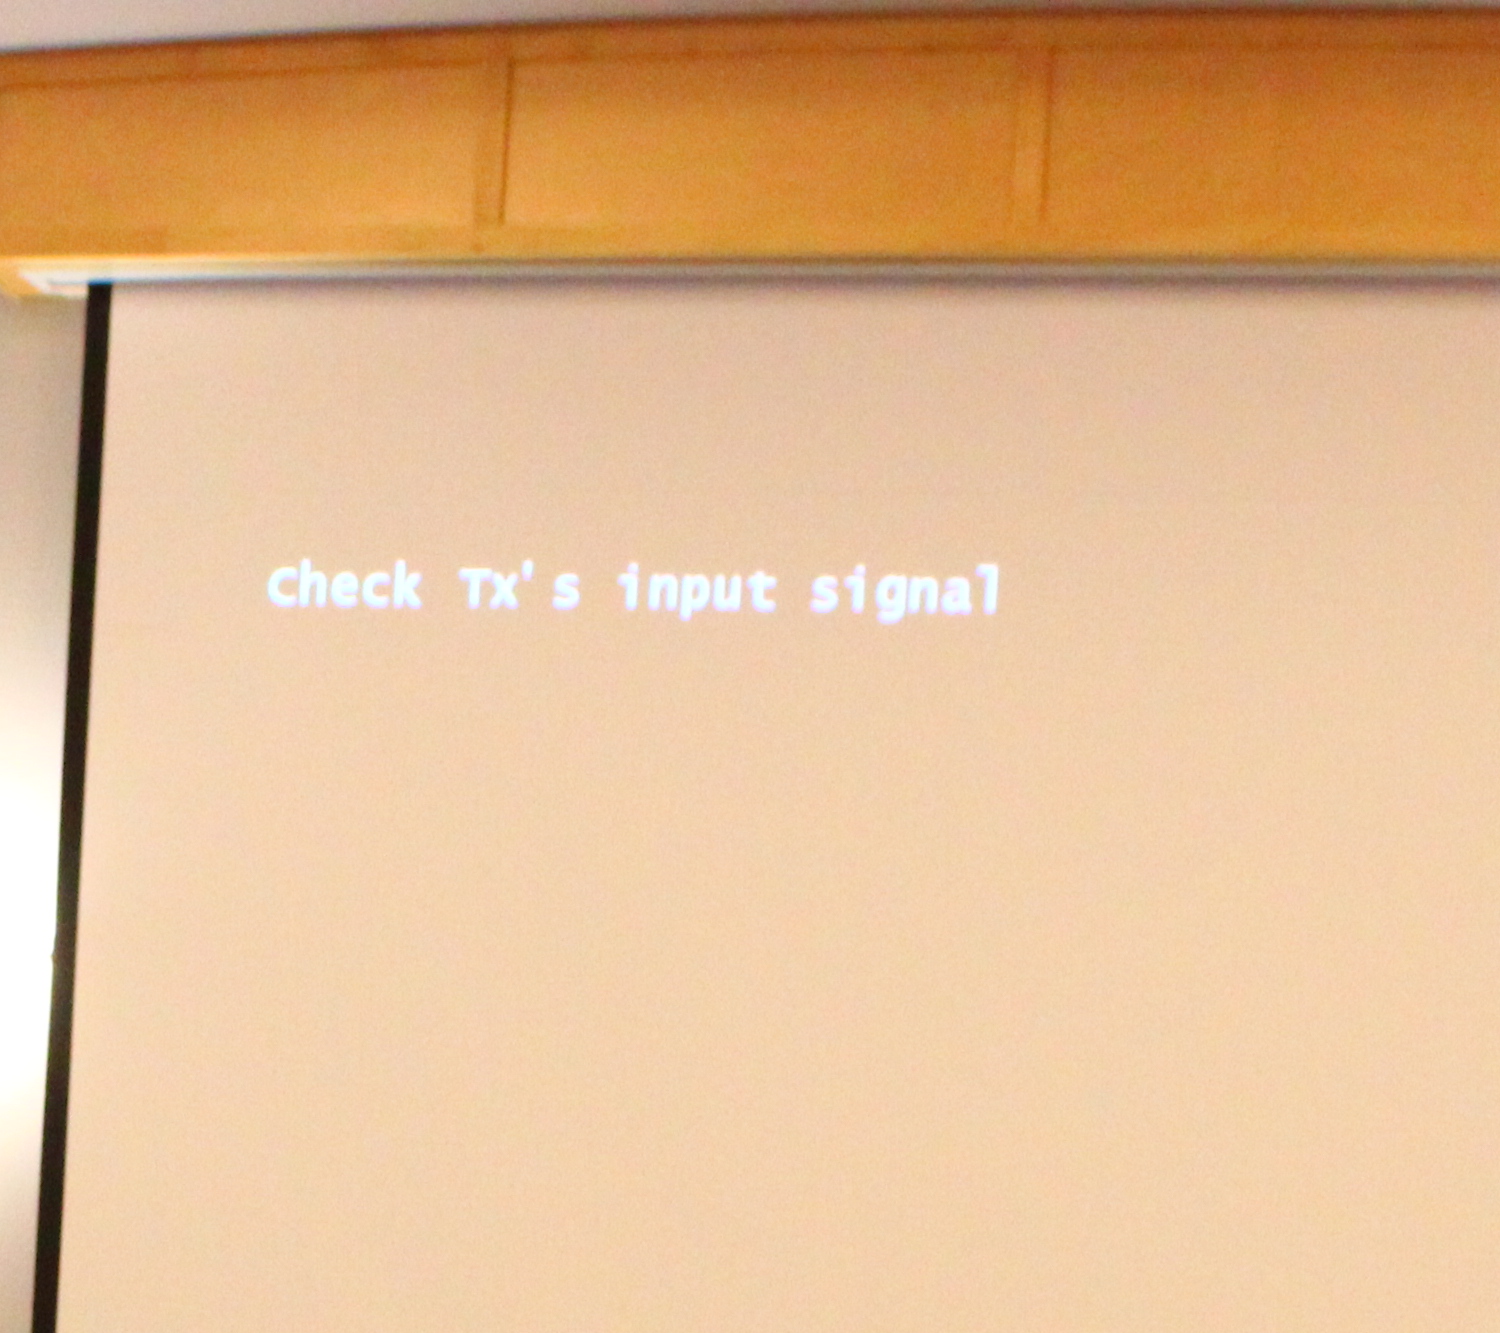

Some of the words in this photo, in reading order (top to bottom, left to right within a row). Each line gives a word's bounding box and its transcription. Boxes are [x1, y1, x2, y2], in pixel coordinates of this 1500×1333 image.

[266, 558, 422, 609] Check
[457, 558, 581, 610] Tx's
[616, 561, 778, 622] input
[808, 563, 999, 625] signal
